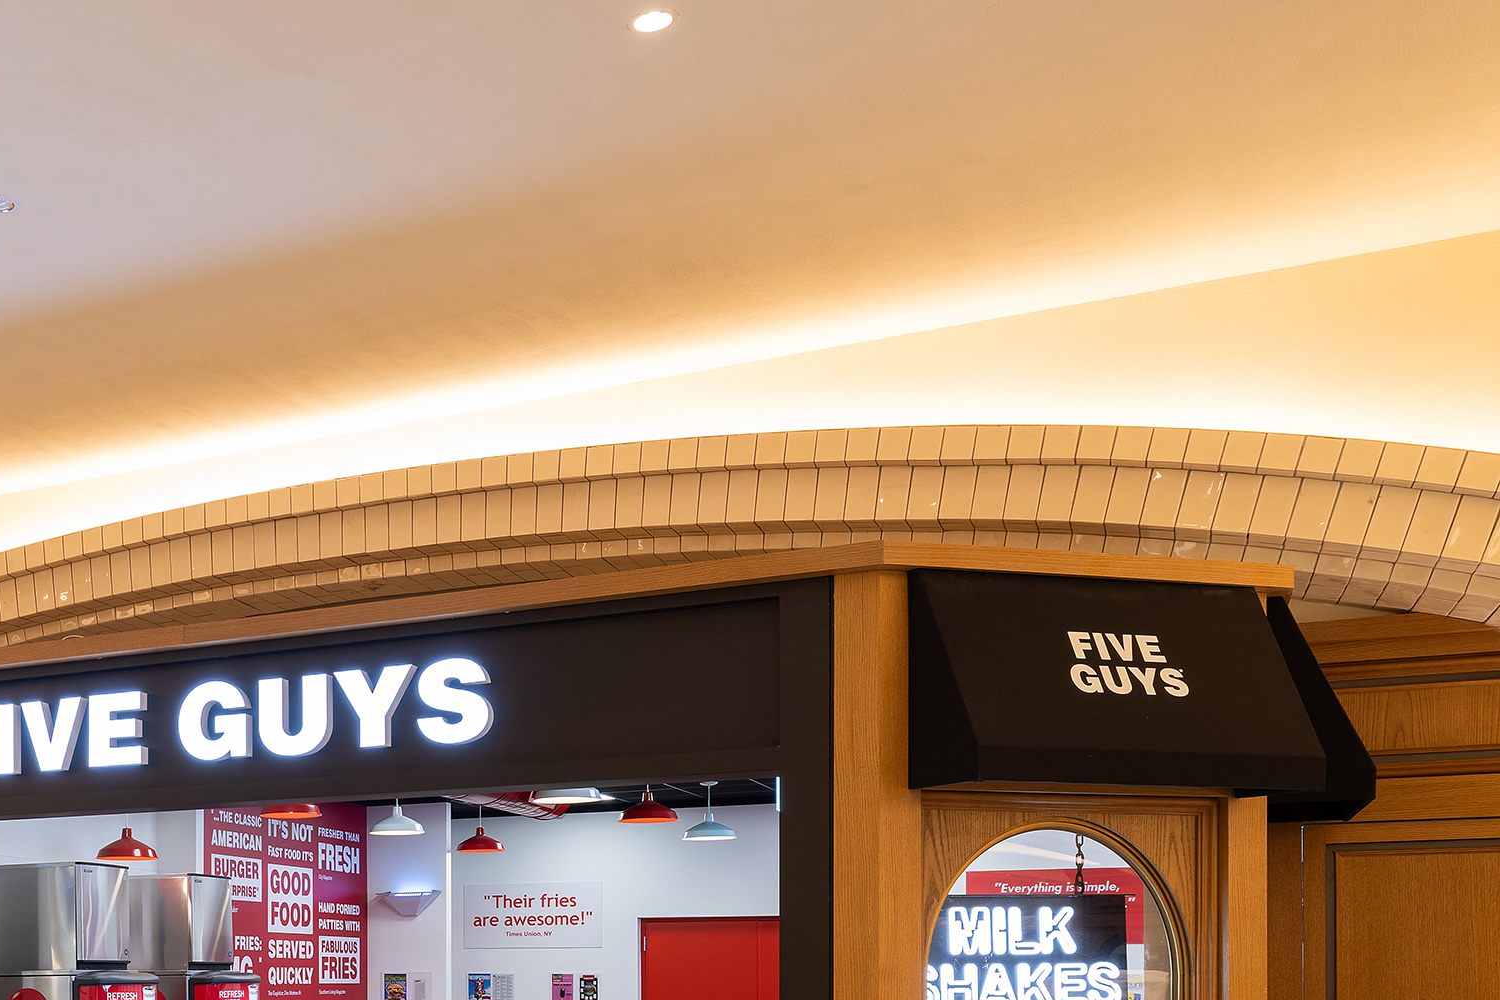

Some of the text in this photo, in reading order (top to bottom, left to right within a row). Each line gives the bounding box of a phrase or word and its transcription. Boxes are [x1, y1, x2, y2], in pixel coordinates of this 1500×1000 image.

[1067, 631, 1167, 663] FIVE
[1070, 663, 1190, 697] GUYS
[178, 657, 494, 763] GUYS
[234, 814, 262, 828] CLASSIC
[211, 829, 262, 851] AMERICAN
[268, 819, 314, 843] IT'S NOT
[318, 827, 360, 843] FRESHER THAN
[268, 845, 314, 862] FAST FOOD IT'S
[318, 842, 360, 874] FRESH
[214, 857, 259, 879] BURGER
[231, 884, 259, 898] RPRISE"
[270, 869, 311, 896] GOOD
[994, 882, 1062, 895] "Everything
[1066, 881, 1075, 892] is
[318, 902, 360, 916] HAND FORMED
[484, 893, 577, 909] "Their fries
[271, 901, 311, 927] FOOD
[473, 911, 593, 927] are awesome!"
[318, 919, 360, 932] PATTIES WITH
[948, 905, 1077, 956] MILK
[235, 936, 263, 951] FRIES:
[268, 939, 314, 959] SERVED
[321, 940, 358, 954] FABULOUS
[268, 966, 314, 985] QUICKLY
[322, 956, 358, 979] FRIES
[106, 992, 138, 1000] REFRESH
[219, 990, 245, 999] REFRESH
